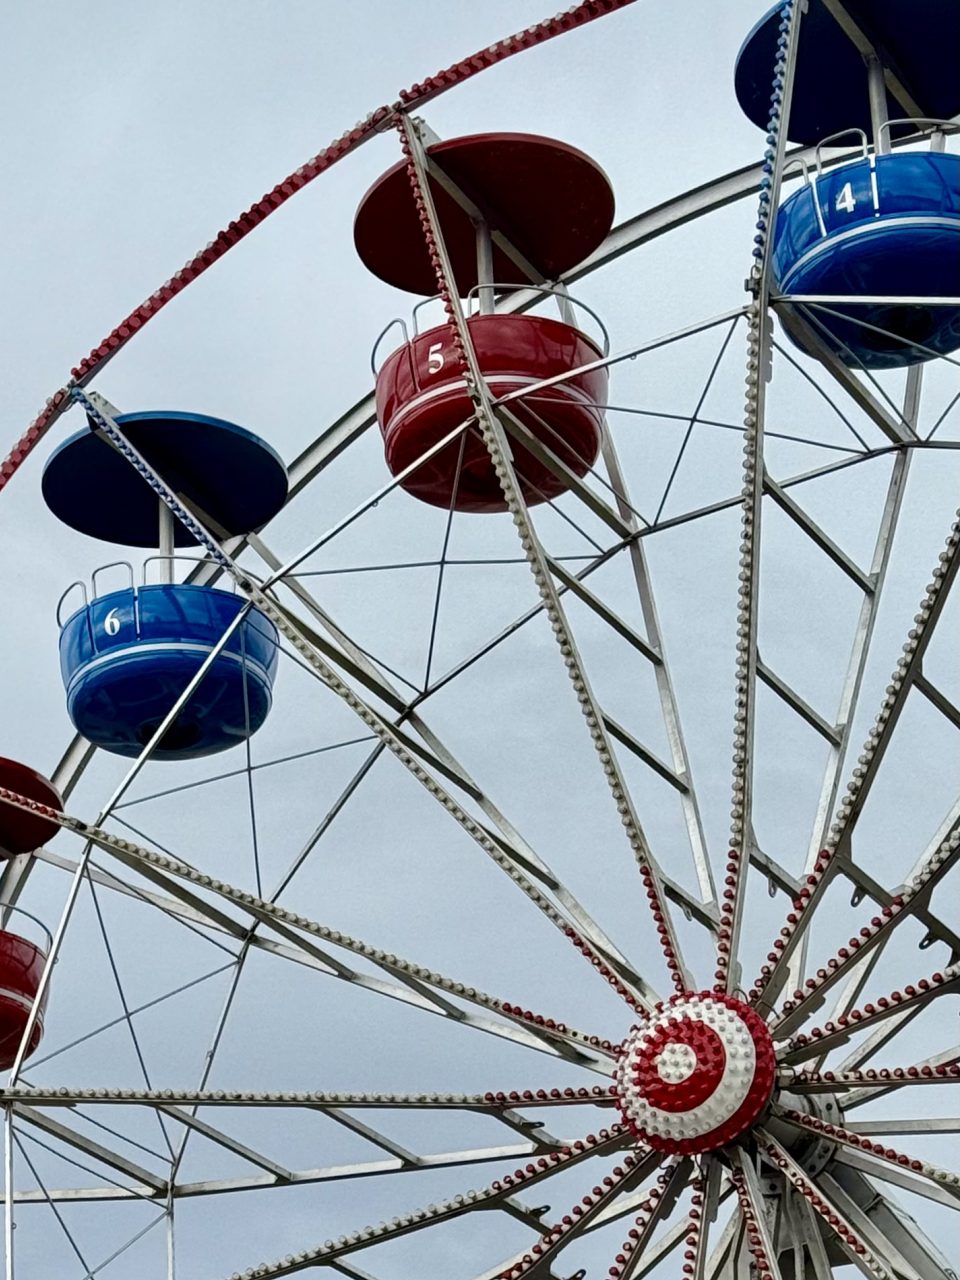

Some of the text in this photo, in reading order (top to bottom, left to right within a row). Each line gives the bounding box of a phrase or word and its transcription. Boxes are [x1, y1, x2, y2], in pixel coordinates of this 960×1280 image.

[835, 182, 857, 213] 4
[428, 343, 445, 374] 5
[103, 607, 121, 636] 6
